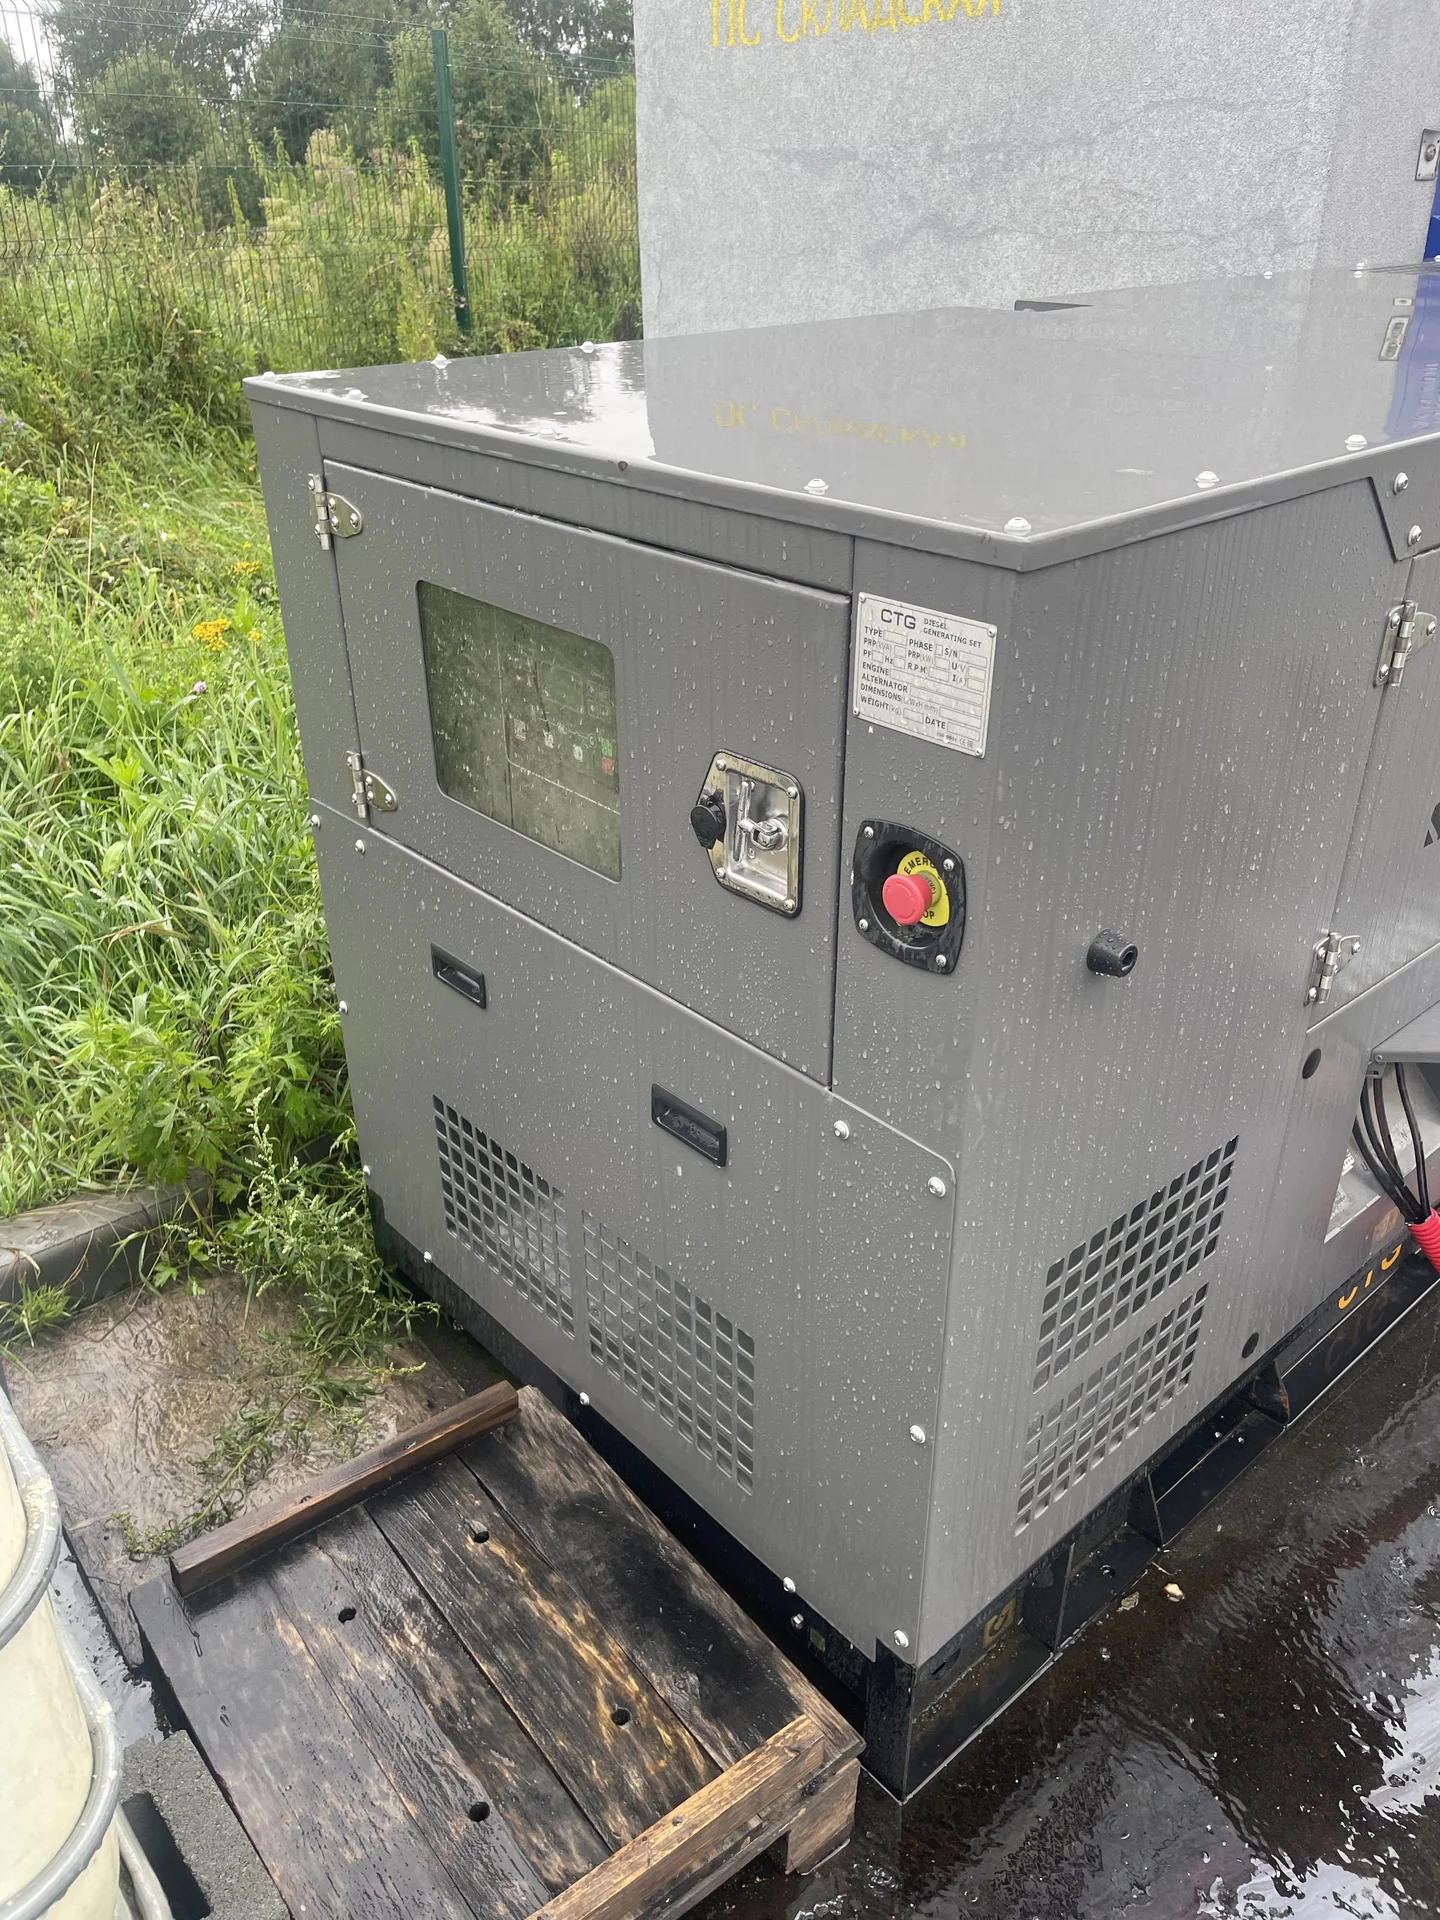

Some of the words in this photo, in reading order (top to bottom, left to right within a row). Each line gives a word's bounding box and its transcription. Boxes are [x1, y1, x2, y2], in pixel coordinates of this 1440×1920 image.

[881, 608, 916, 630] CTG
[924, 618, 948, 630] DIESEL
[864, 626, 883, 638] TYPE
[923, 627, 967, 644] GENERATING
[969, 638, 982, 648] SET
[909, 638, 933, 651] PHASE
[863, 649, 872, 658] PF
[944, 647, 958, 658] S/N
[885, 655, 894, 665] Hz
[862, 661, 889, 676] ENGINE
[861, 673, 908, 693] ALTERNATOR
[925, 716, 946, 730] DATE
[923, 910, 935, 920] OP
